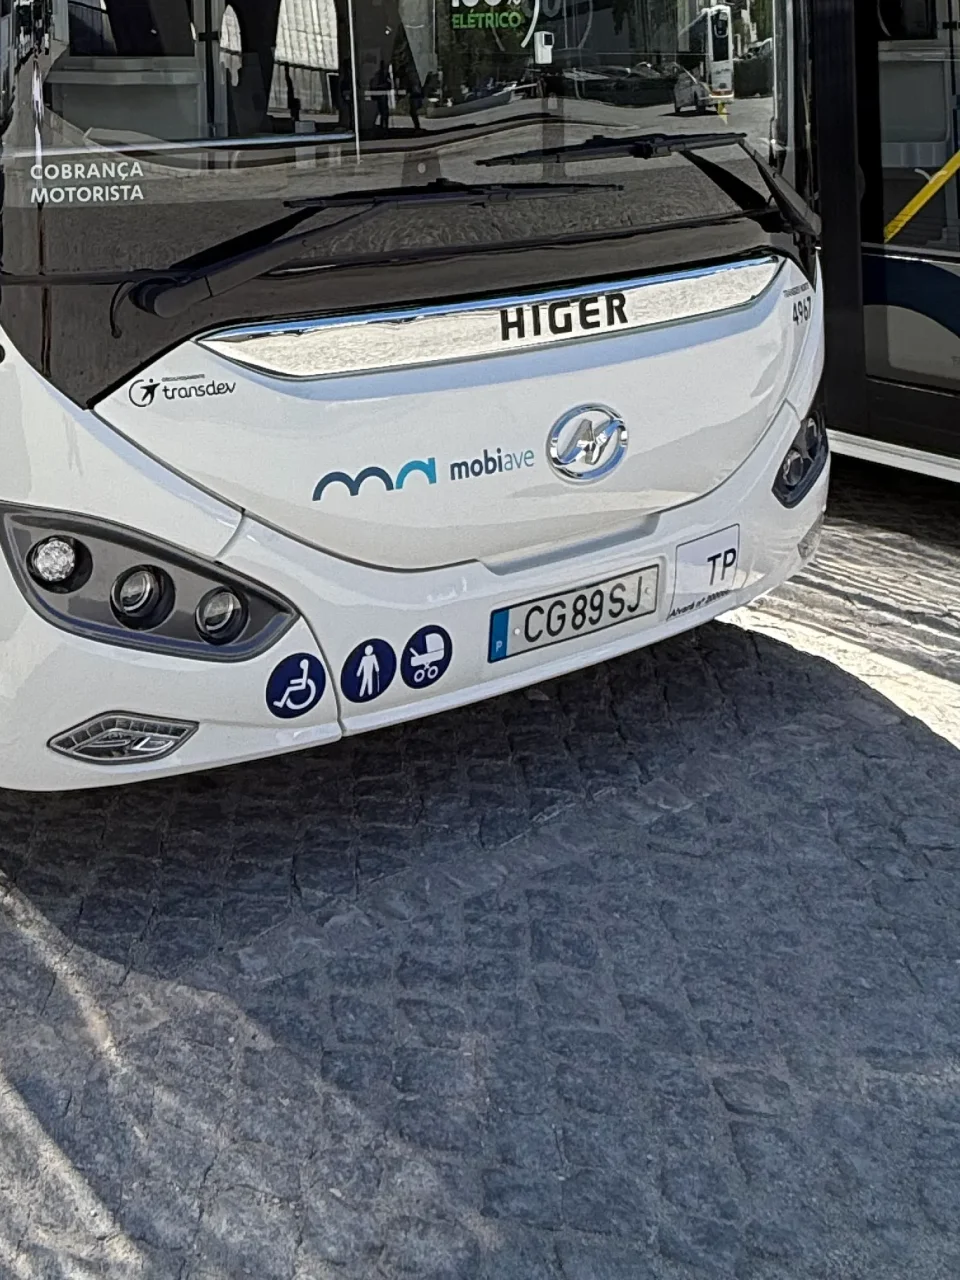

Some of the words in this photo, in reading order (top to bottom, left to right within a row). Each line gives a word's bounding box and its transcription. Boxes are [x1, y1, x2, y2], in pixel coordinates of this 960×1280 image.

[451, 8, 522, 29] ELÉTRICO
[30, 161, 144, 181] COBRANÇA
[30, 185, 144, 204] MOTORISTA
[499, 293, 629, 341] HIGER
[792, 295, 812, 326] 4967
[161, 380, 236, 400] transdev
[449, 447, 535, 481] mobiave
[707, 548, 737, 586] TP
